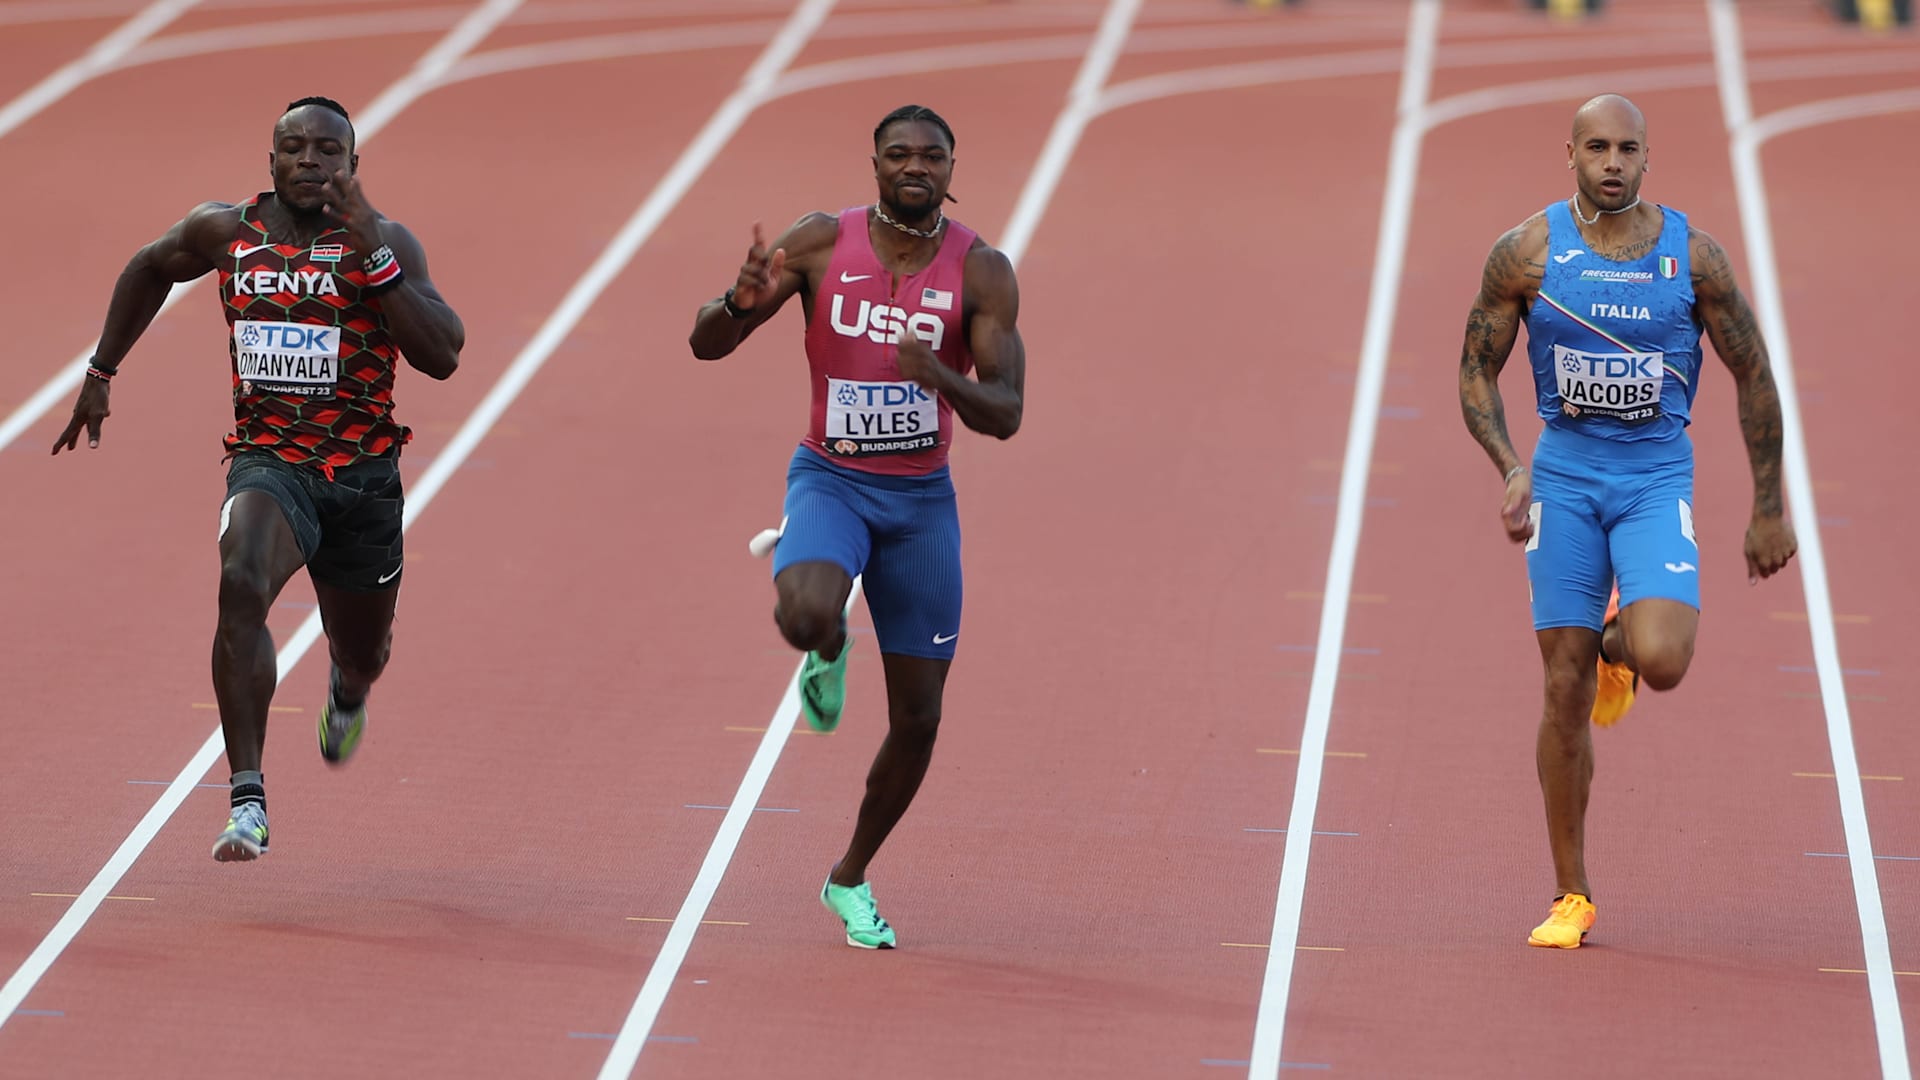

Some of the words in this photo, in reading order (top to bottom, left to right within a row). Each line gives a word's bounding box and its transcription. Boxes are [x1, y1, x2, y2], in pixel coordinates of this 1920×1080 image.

[233, 271, 340, 297] KENYA
[1581, 269, 1654, 280] FRECCIAROSSA
[830, 293, 945, 351] USA
[1591, 303, 1651, 321] ITALIA
[260, 325, 332, 352] TDK
[239, 352, 332, 379] OMANYALA
[1581, 355, 1655, 379] TDK
[317, 386, 331, 396] 23
[857, 383, 930, 407] TDK
[1561, 378, 1655, 406] JACOBS
[845, 410, 921, 436] LYLES
[1640, 407, 1654, 418] 23
[860, 439, 921, 452] BUDAPEST
[921, 436, 935, 447] 23
